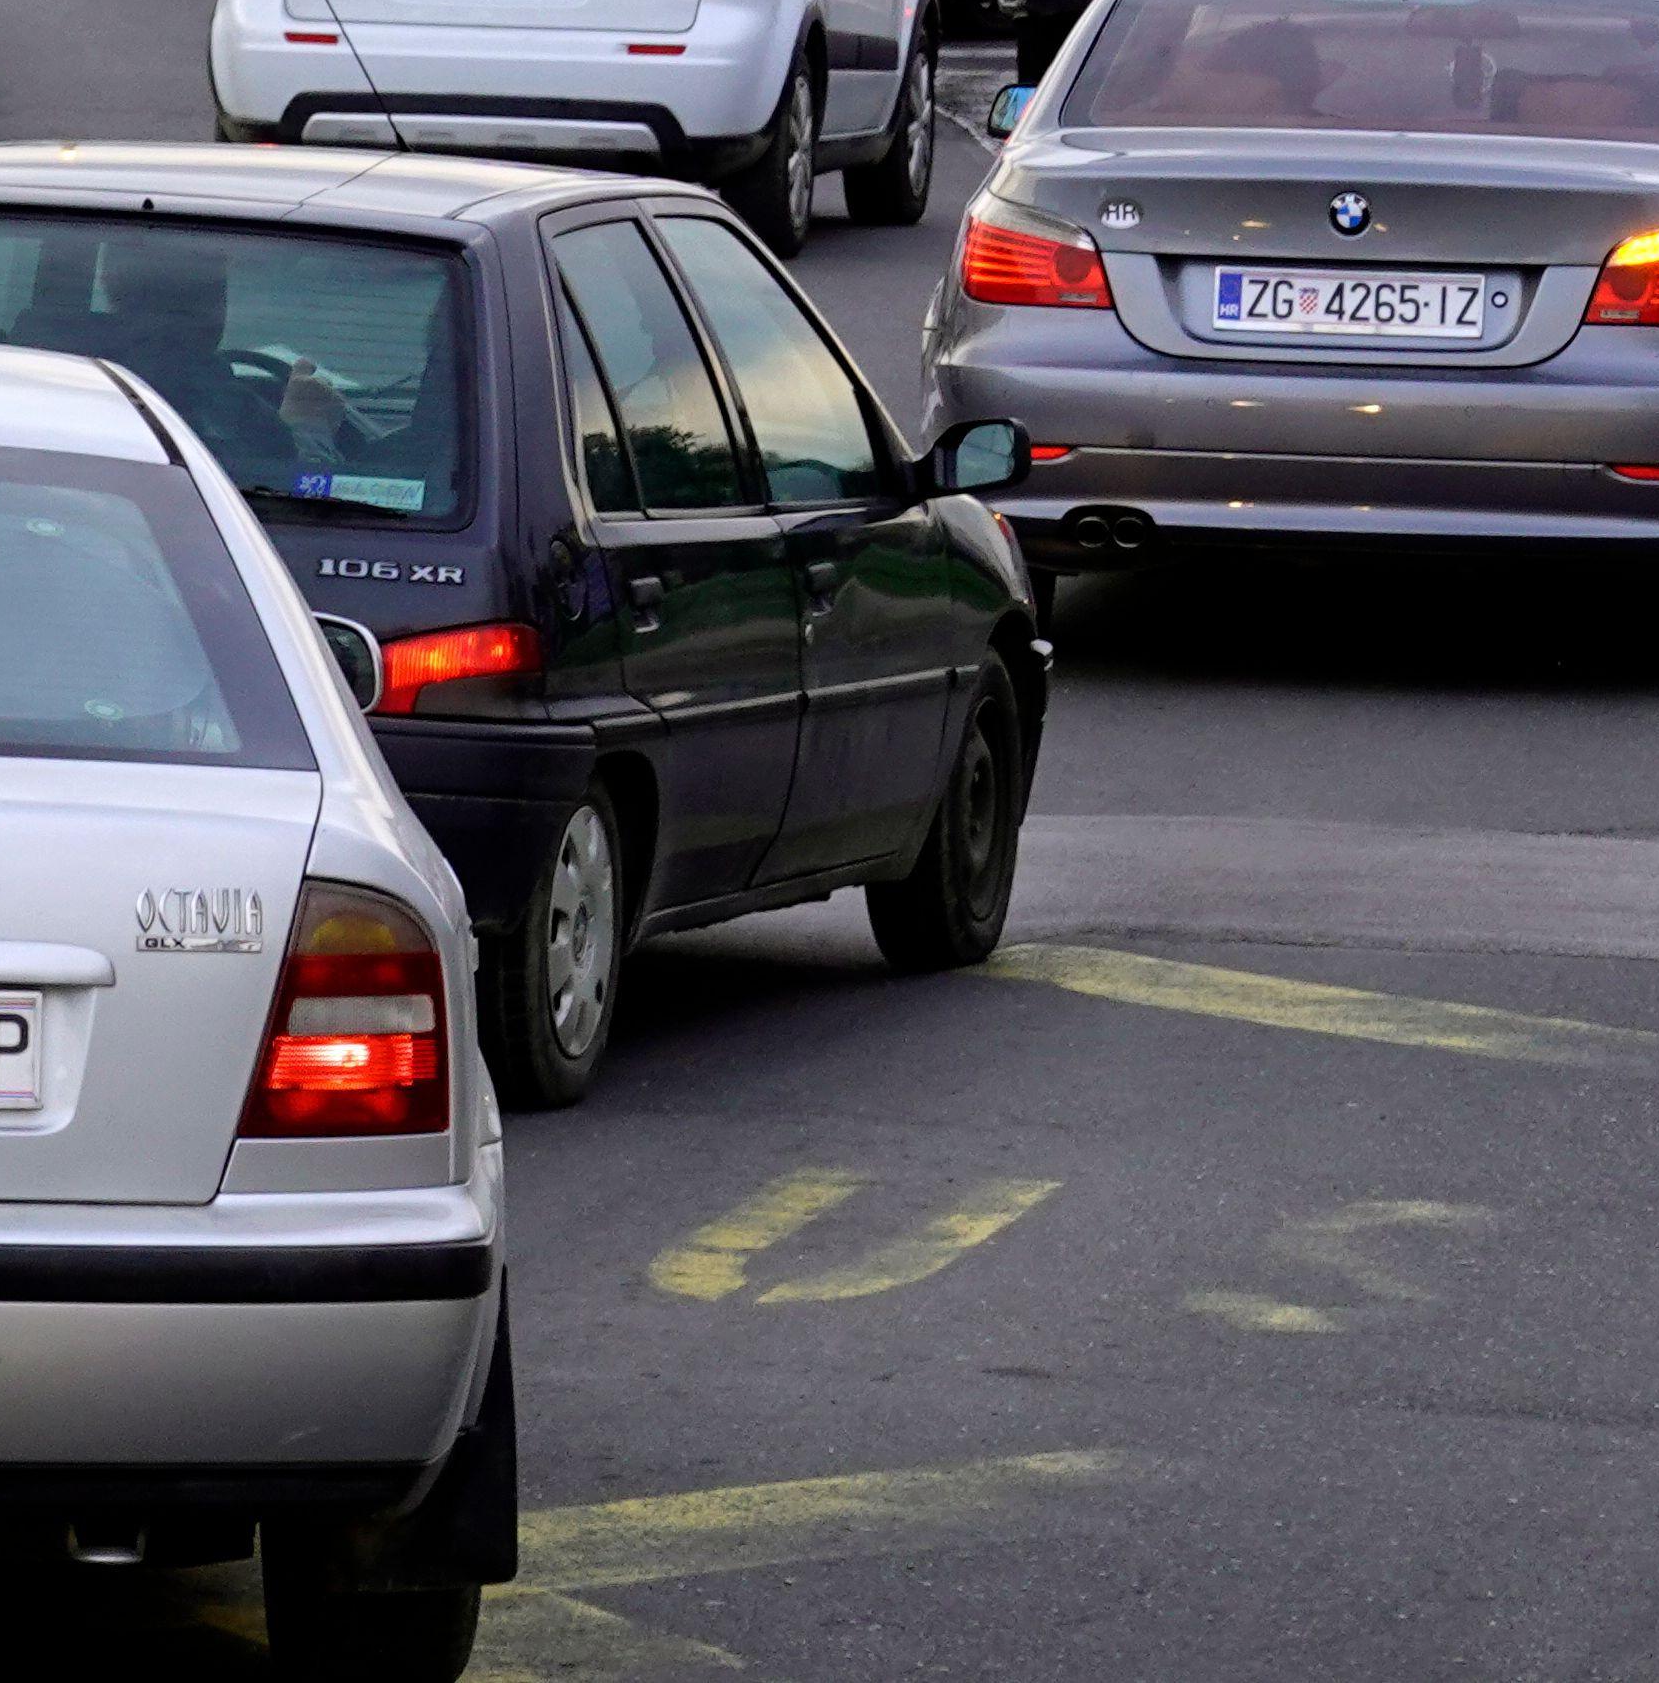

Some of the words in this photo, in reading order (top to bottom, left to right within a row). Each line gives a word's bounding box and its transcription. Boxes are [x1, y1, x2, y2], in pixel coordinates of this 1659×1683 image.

[1219, 304, 1239, 317] HR
[1247, 279, 1293, 319] ZG
[318, 558, 401, 581] 106
[410, 565, 463, 585] XR
[136, 887, 263, 934] OCTAVIA
[145, 937, 186, 949] GLX
